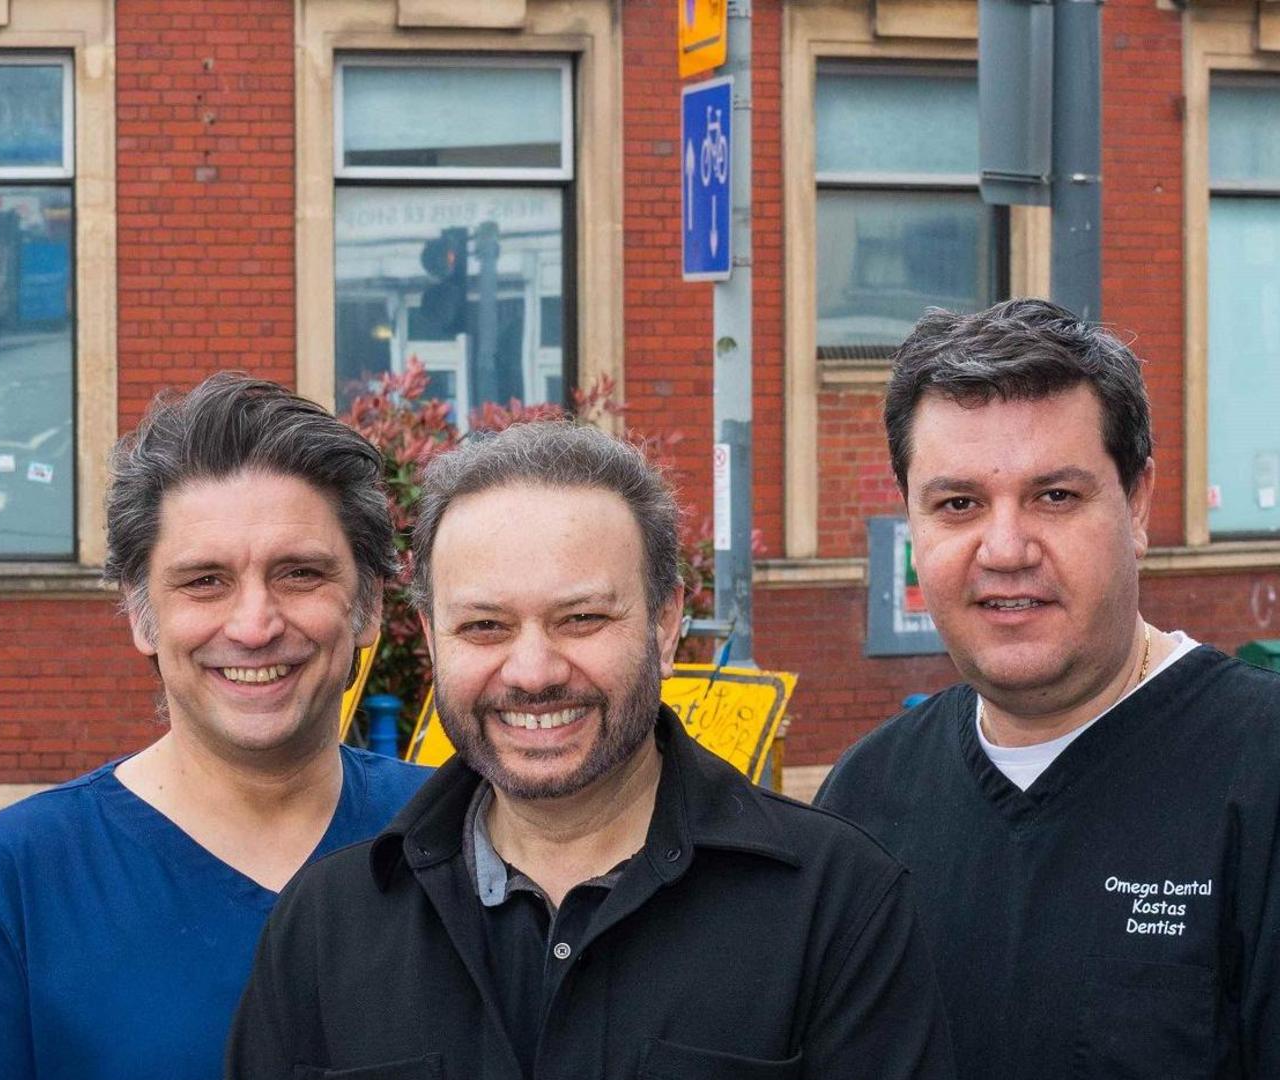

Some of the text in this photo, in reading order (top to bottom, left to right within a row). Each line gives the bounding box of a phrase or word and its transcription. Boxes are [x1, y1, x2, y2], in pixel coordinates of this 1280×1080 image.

[1105, 876, 1213, 898] Omega Dental
[1132, 899, 1186, 916] Kostas
[1126, 918, 1186, 936] Dentist
